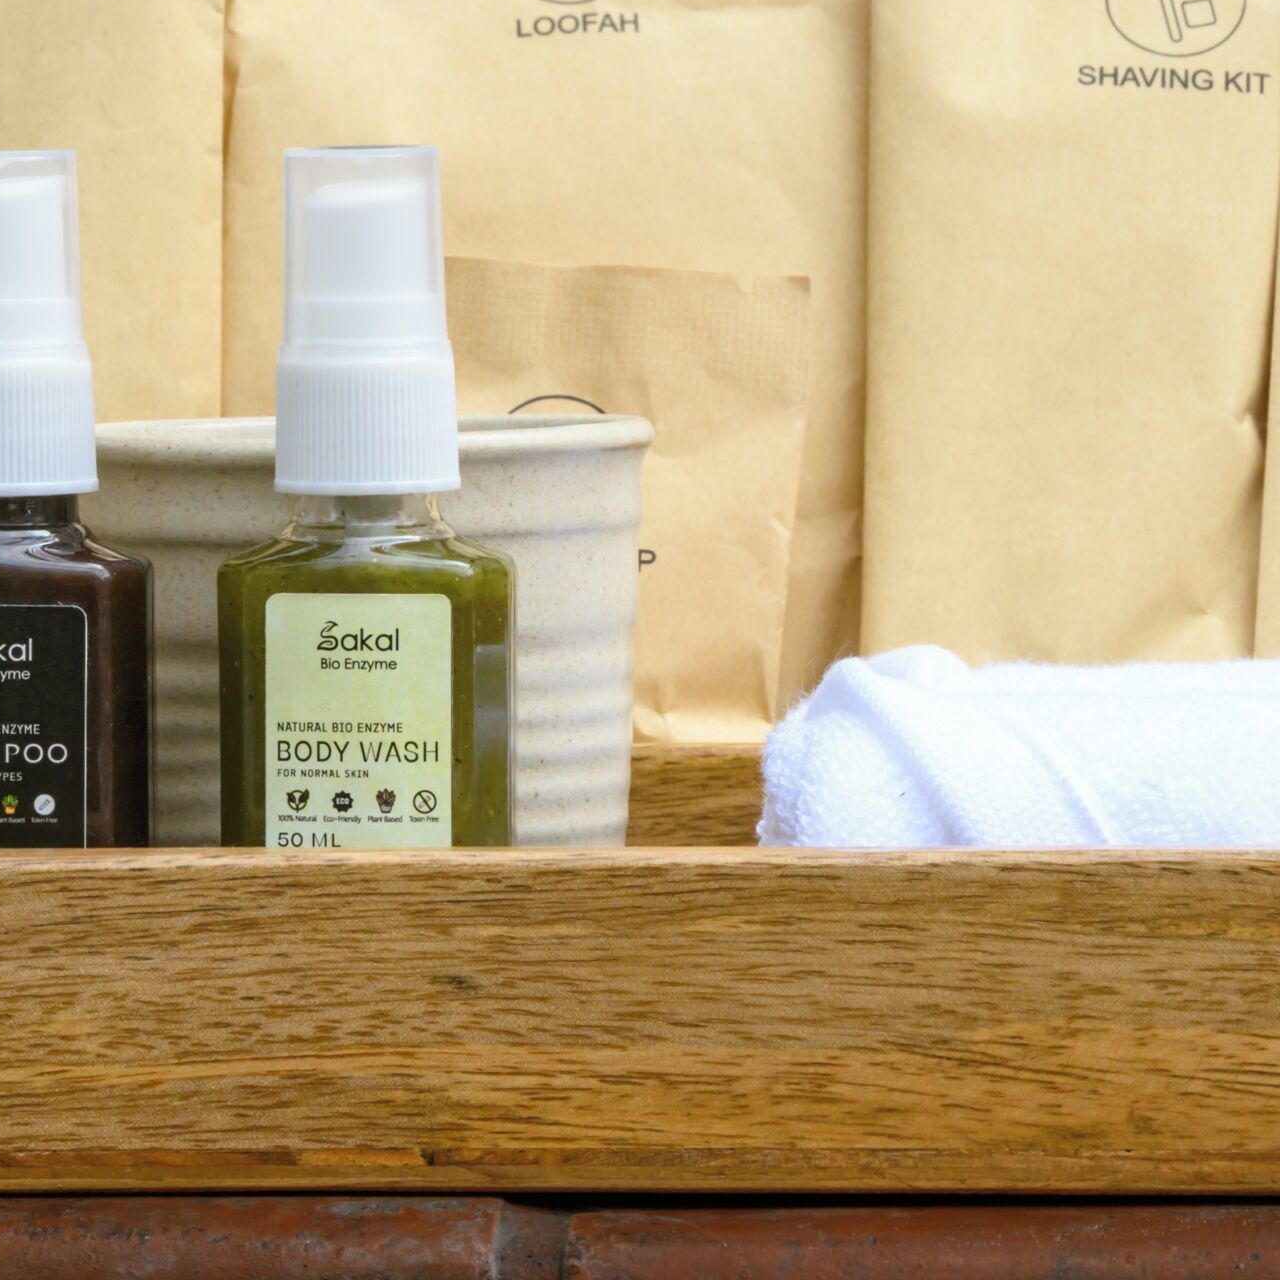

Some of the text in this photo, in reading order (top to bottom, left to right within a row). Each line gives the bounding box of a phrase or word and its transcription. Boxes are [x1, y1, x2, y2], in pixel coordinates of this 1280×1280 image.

[516, 13, 639, 37] LOOFAH
[1078, 65, 1271, 95] SHAVING KIT
[317, 621, 399, 651] Sakal
[321, 658, 397, 672] Bio Enzyme
[277, 722, 403, 733] NATURAL BIO ENZYME
[277, 741, 439, 762] BODY WASH
[277, 769, 369, 778] FOR NORMAL SKIN
[323, 816, 361, 824] Eco-Friendly
[278, 832, 341, 847] 50 ML
